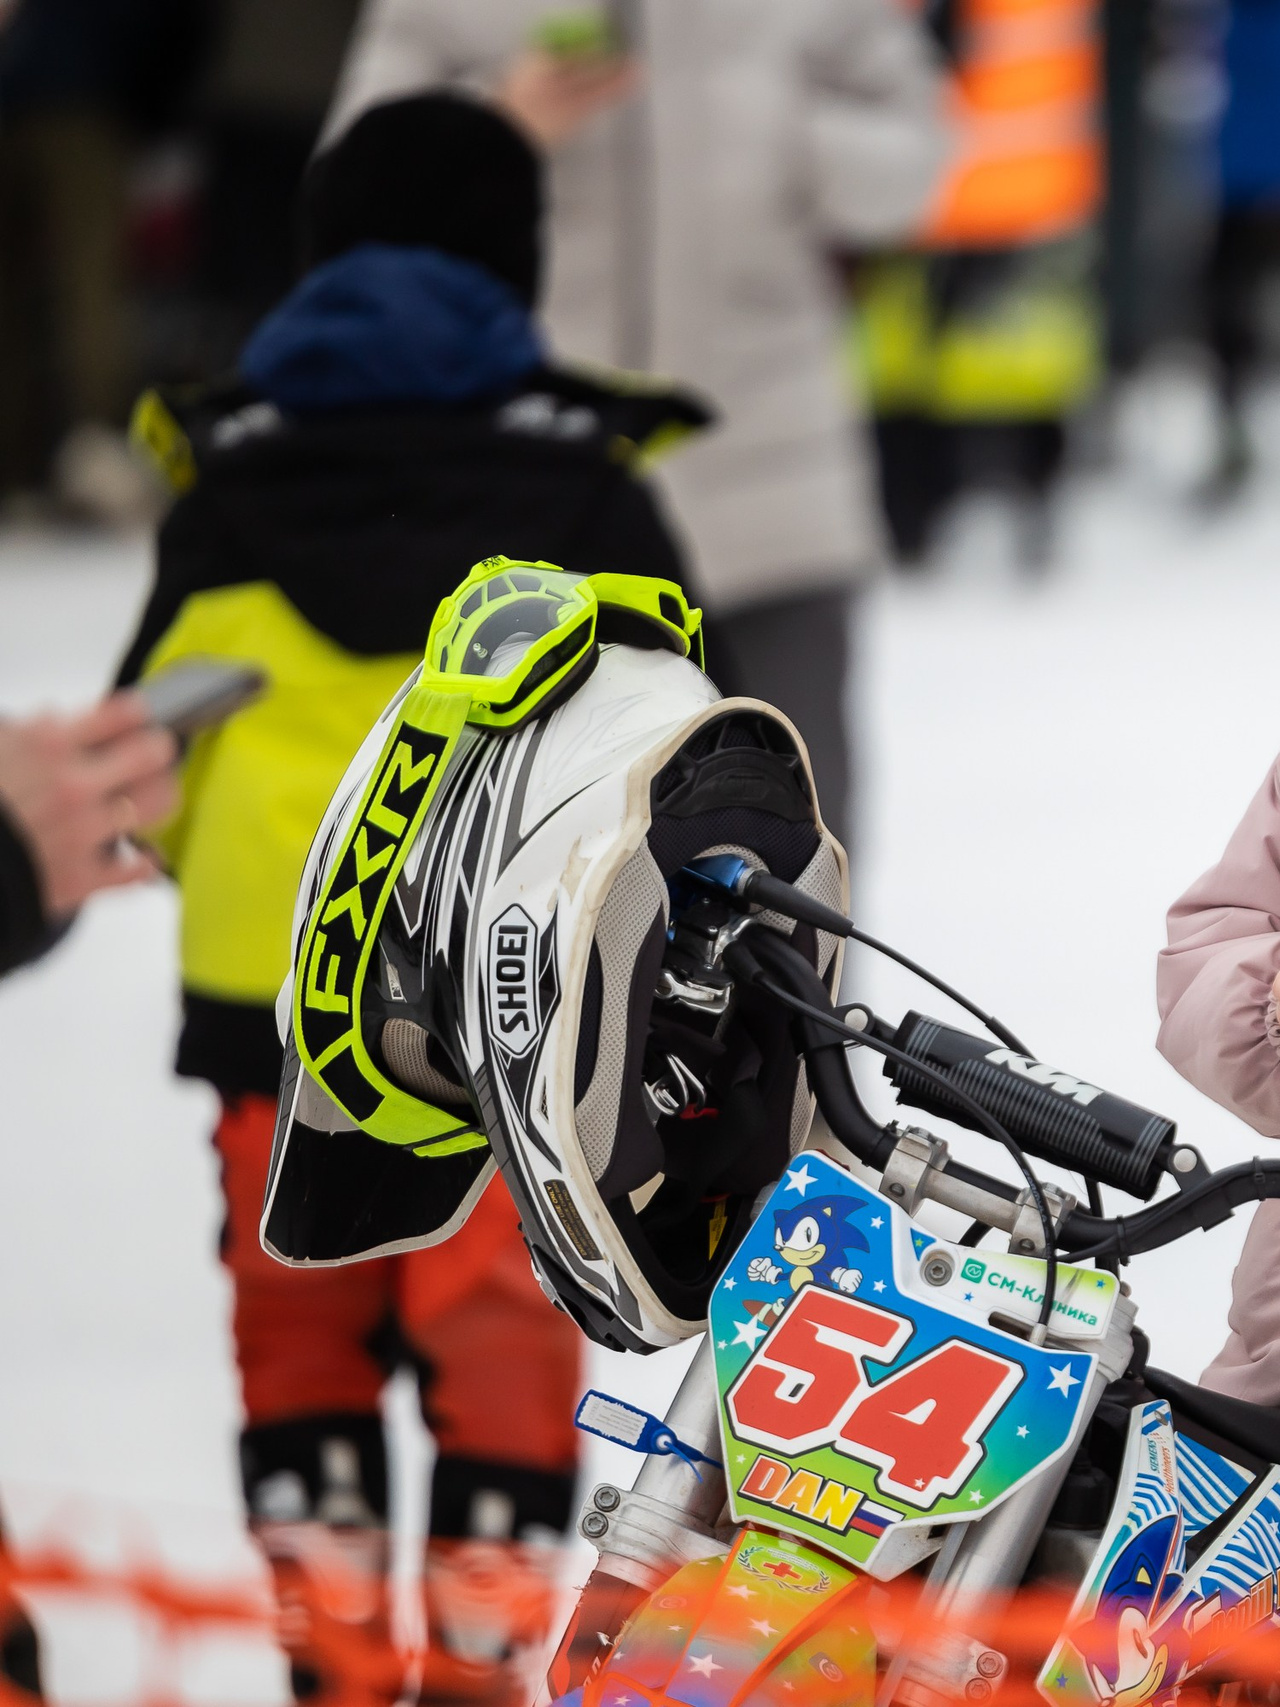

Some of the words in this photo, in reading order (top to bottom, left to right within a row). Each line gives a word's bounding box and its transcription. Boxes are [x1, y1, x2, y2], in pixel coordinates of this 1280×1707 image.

[304, 740, 436, 1014] FXR
[496, 924, 530, 1033] SHOEI
[545, 1185, 559, 1204] ONLY
[729, 1286, 1018, 1502] 54
[737, 1453, 866, 1532] DAN
[1147, 1438, 1160, 1473] SIEMENS
